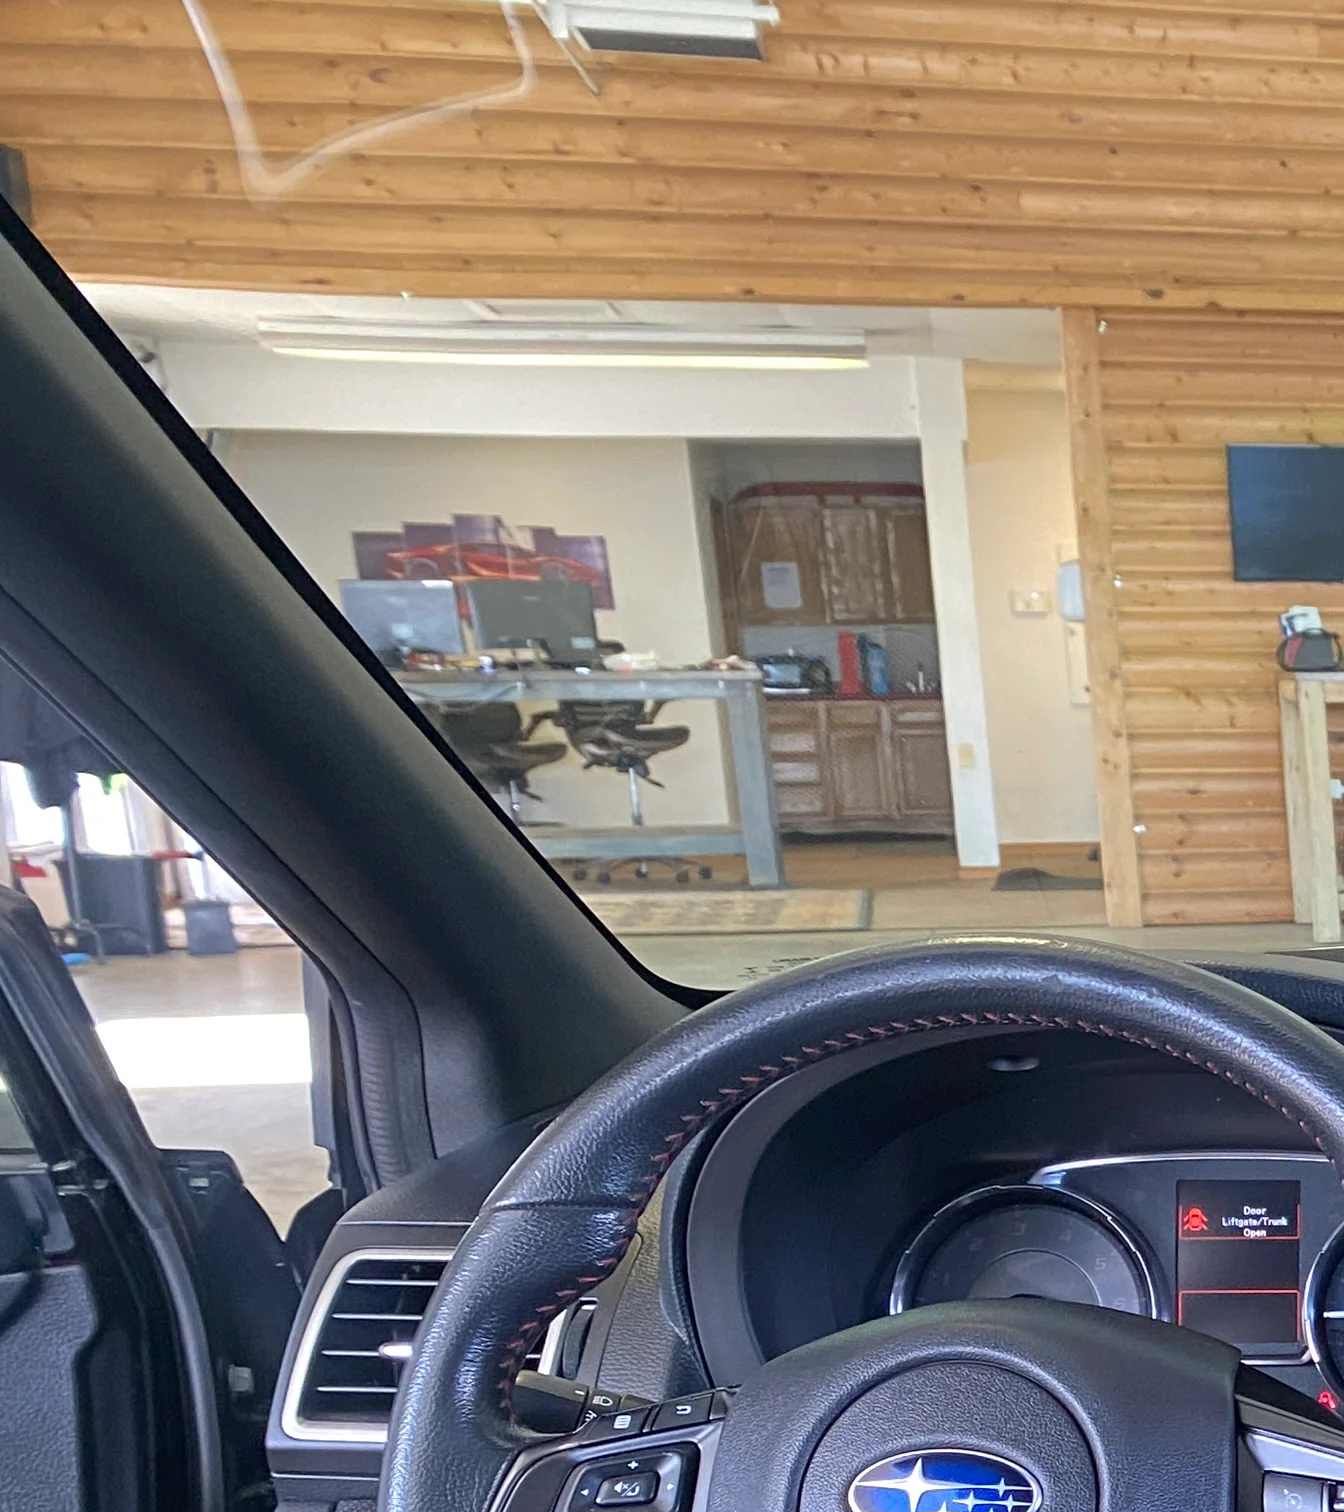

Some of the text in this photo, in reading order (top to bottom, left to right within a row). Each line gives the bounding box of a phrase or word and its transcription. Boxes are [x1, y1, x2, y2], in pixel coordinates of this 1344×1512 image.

[1243, 1206, 1267, 1216] Door
[1221, 1217, 1288, 1228] Liftgate/Trunk
[1243, 1229, 1267, 1238] Open
